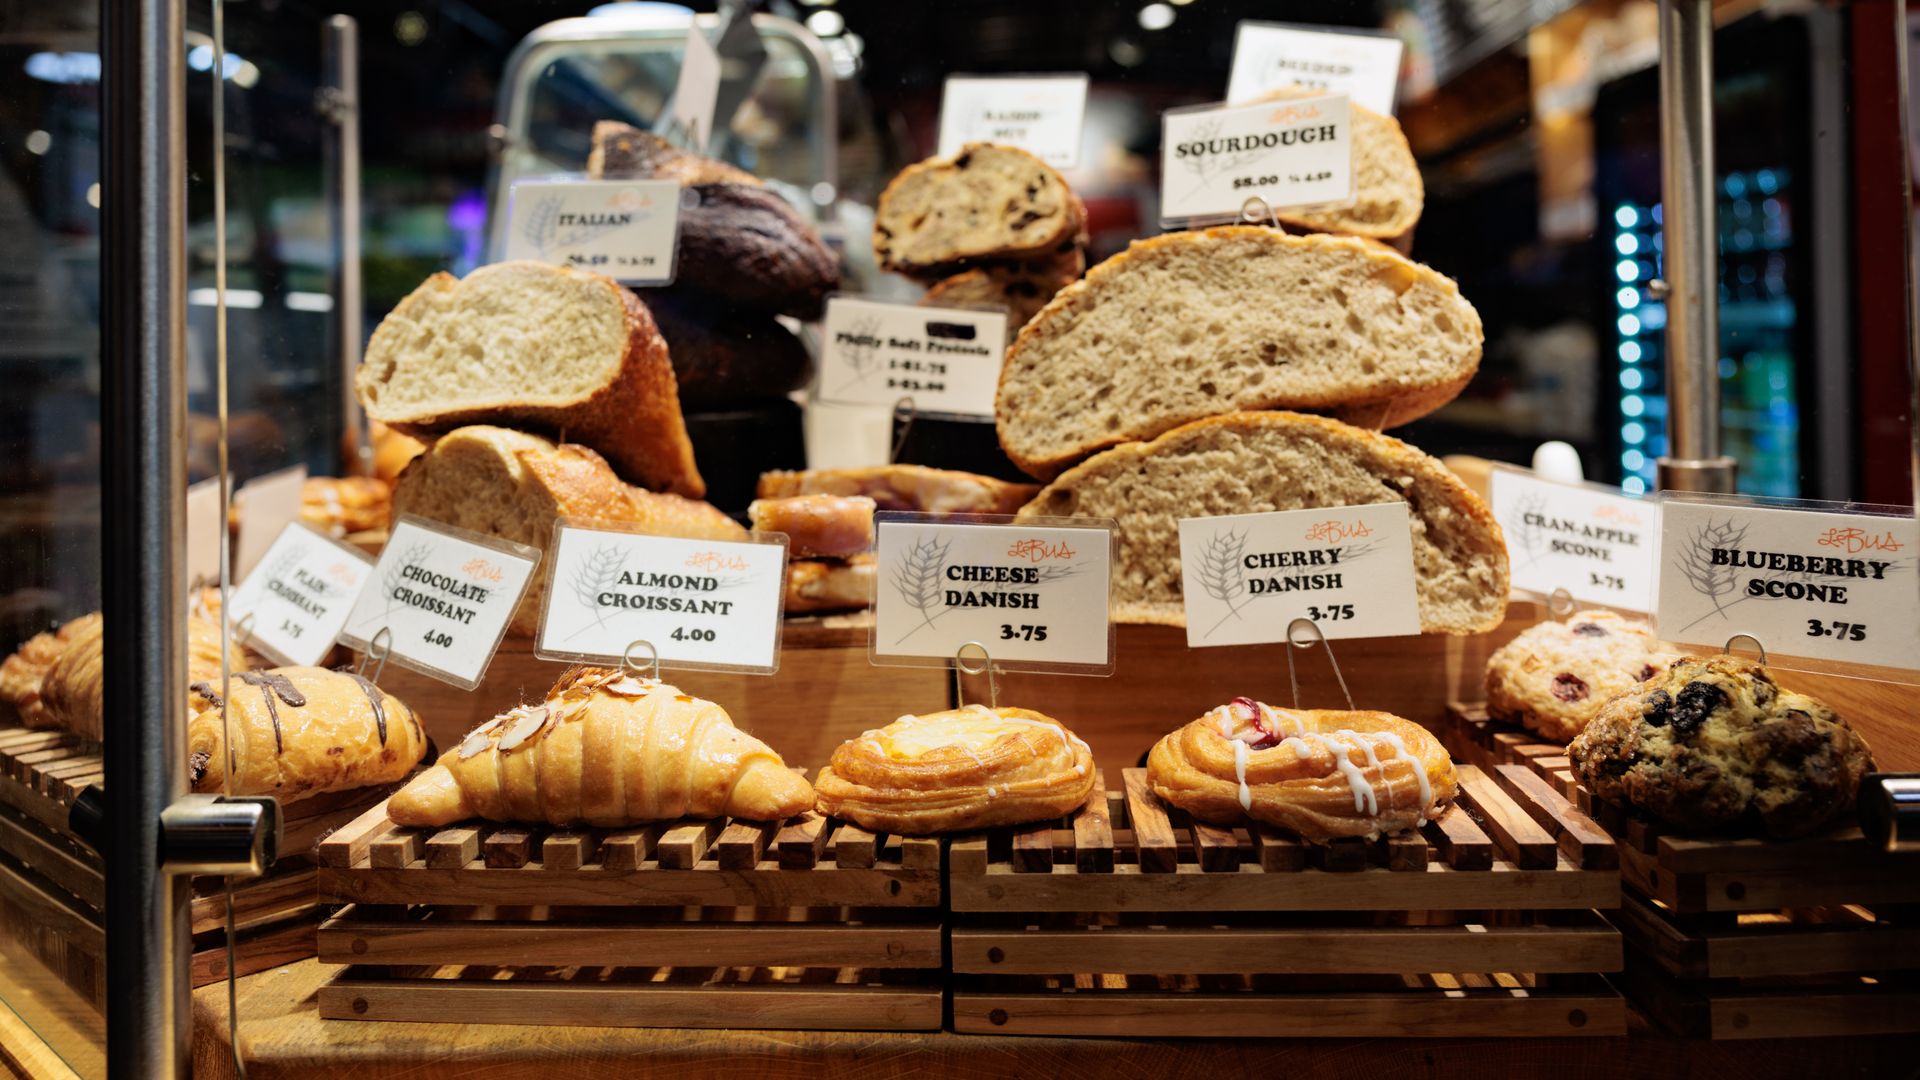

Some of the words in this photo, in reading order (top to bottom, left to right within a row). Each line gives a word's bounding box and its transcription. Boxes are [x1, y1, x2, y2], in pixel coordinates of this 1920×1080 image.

[1175, 125, 1337, 158] SOURDOUGH
[558, 213, 632, 226] ITALIAN
[1523, 512, 1640, 546] CRAN-APPLE
[1244, 548, 1343, 569] CHERRY
[1551, 539, 1613, 562] SCONE
[1710, 548, 1890, 579] BLUEBERRY
[402, 564, 489, 604] CHOCOLATE
[617, 571, 719, 591] ALMOND
[946, 565, 1039, 584] CHEESE
[1248, 573, 1343, 594] DANISH
[1590, 572, 1625, 590] 3.75
[945, 590, 1039, 609] DANISH
[1748, 579, 1848, 604] SCONE
[393, 586, 477, 625] CROISSANT
[597, 592, 733, 615] CROISSANT
[1307, 604, 1355, 621] 3.75
[423, 628, 453, 648] 4.00
[670, 627, 716, 642] 4.00
[1000, 624, 1047, 641] 3.75
[1806, 619, 1867, 641] 3.75
